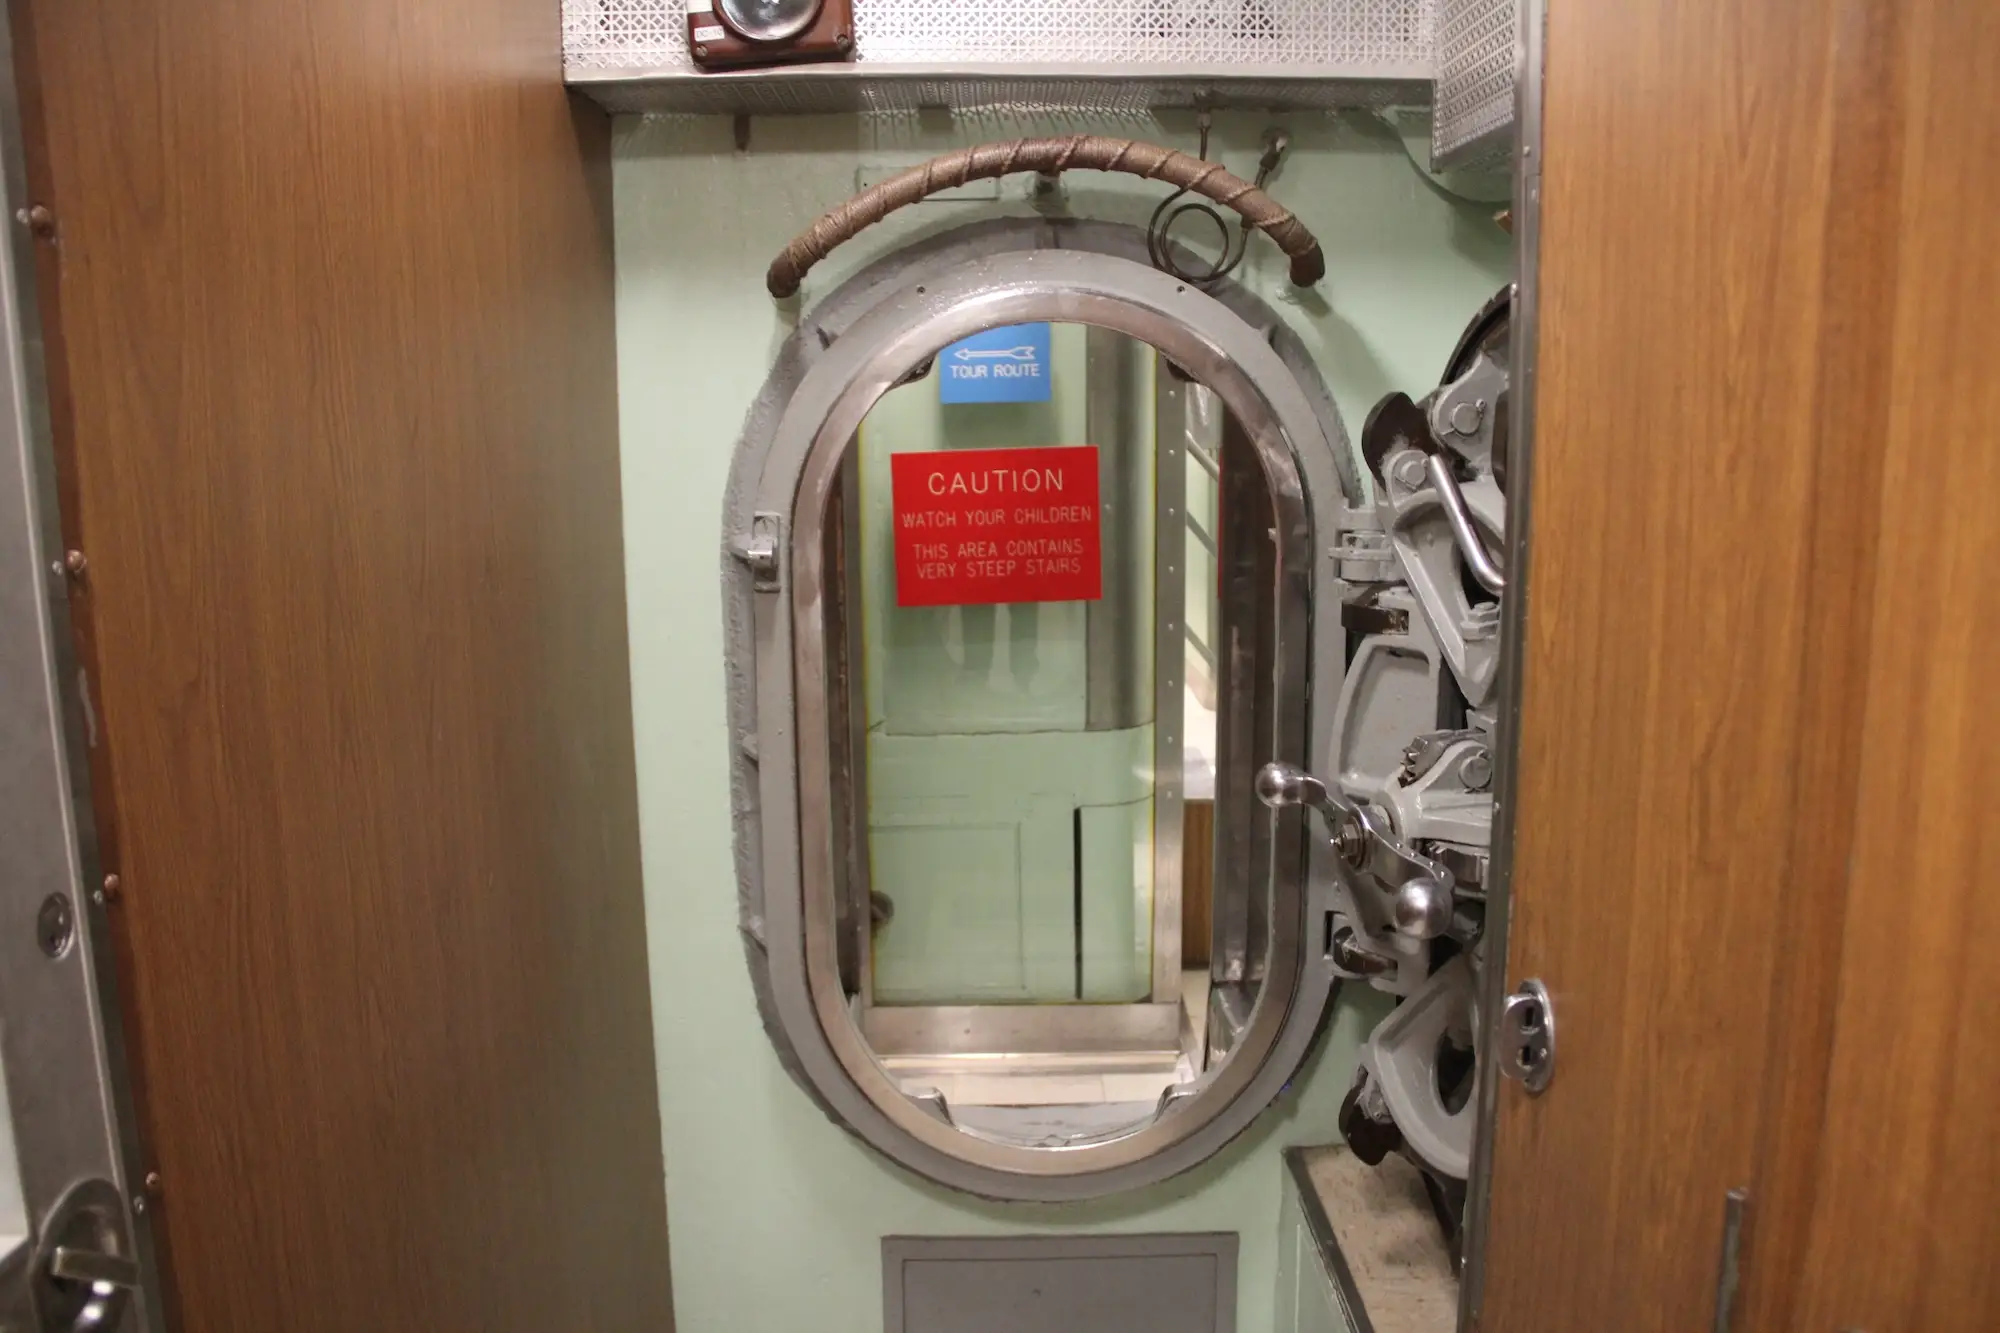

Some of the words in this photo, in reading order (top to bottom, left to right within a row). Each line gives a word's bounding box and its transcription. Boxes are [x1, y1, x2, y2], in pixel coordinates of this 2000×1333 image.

[950, 364, 988, 379] TOUR
[993, 363, 1040, 378] ROUTE
[927, 468, 1064, 495] CAUTION
[902, 511, 956, 528] WATCH
[965, 509, 1005, 526] YOUR
[1014, 506, 1092, 525] CHILDREN
[913, 543, 949, 560] THIS
[957, 541, 998, 558] AREA
[1005, 538, 1084, 556] CONTAINS
[916, 562, 957, 580] VERY
[966, 560, 1016, 578] STEEP
[1025, 557, 1081, 575] STAIRS
